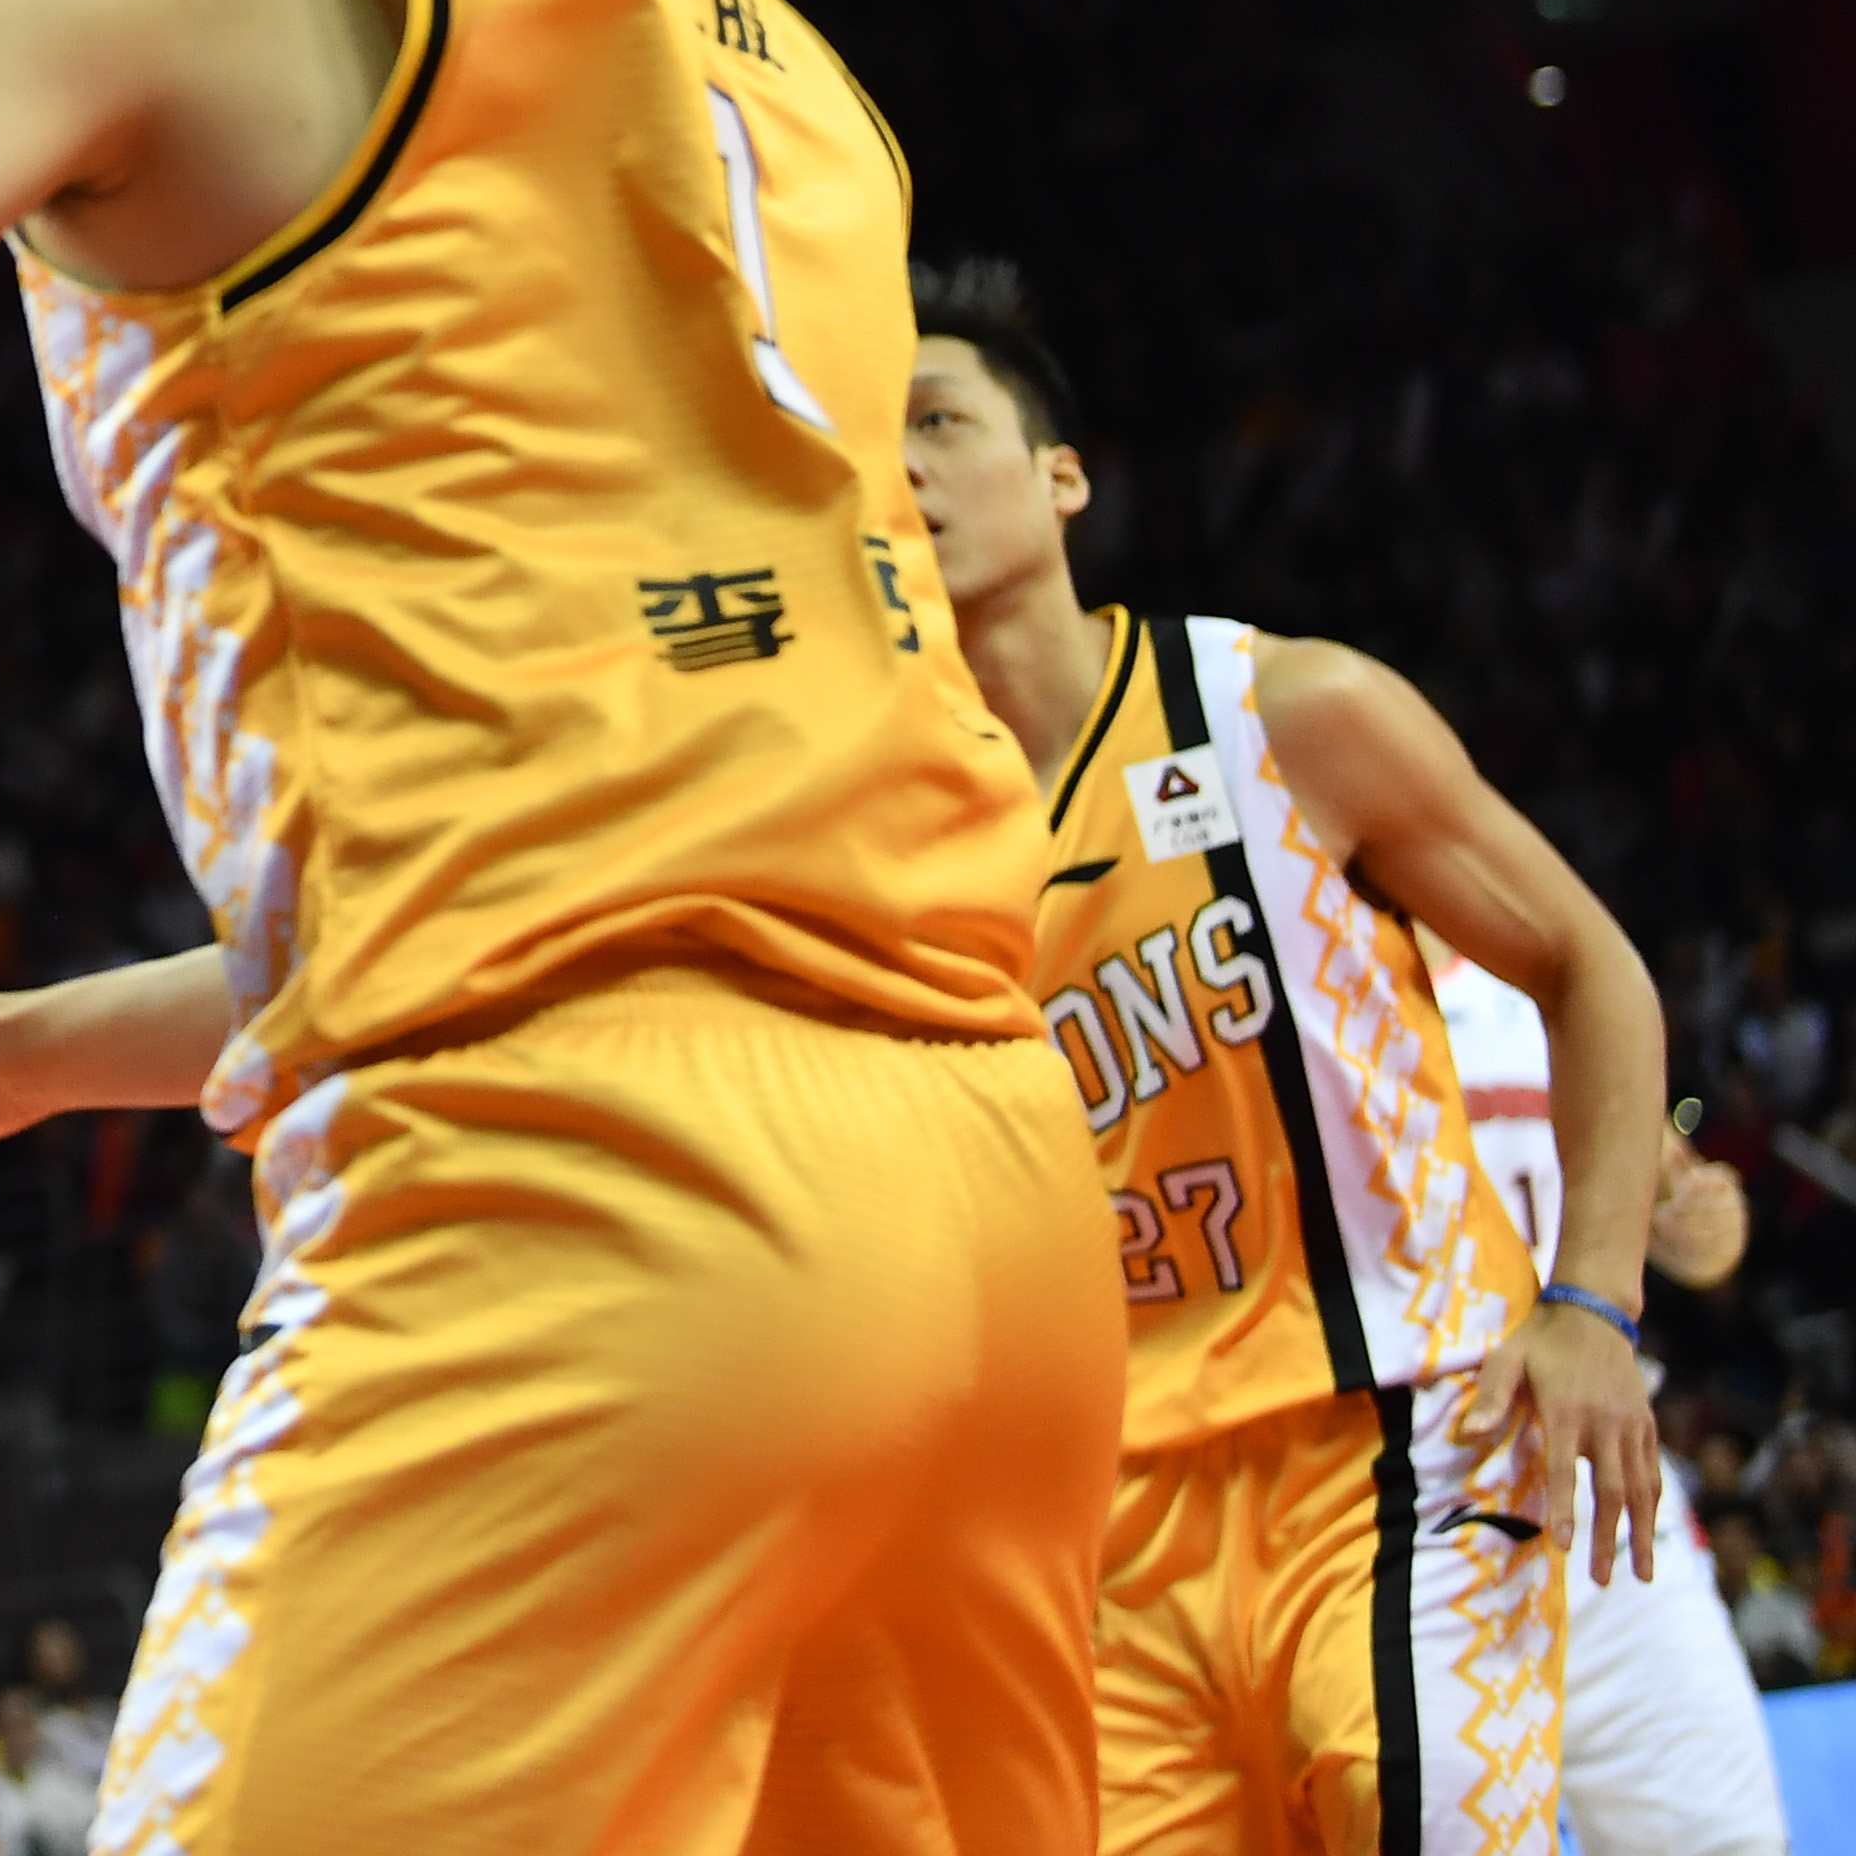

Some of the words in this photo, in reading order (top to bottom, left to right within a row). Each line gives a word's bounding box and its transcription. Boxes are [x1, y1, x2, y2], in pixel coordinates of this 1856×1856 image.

[706, 82, 838, 436] 1
[1040, 894, 1276, 1134] ONS
[1106, 1157, 1243, 1306] 27
